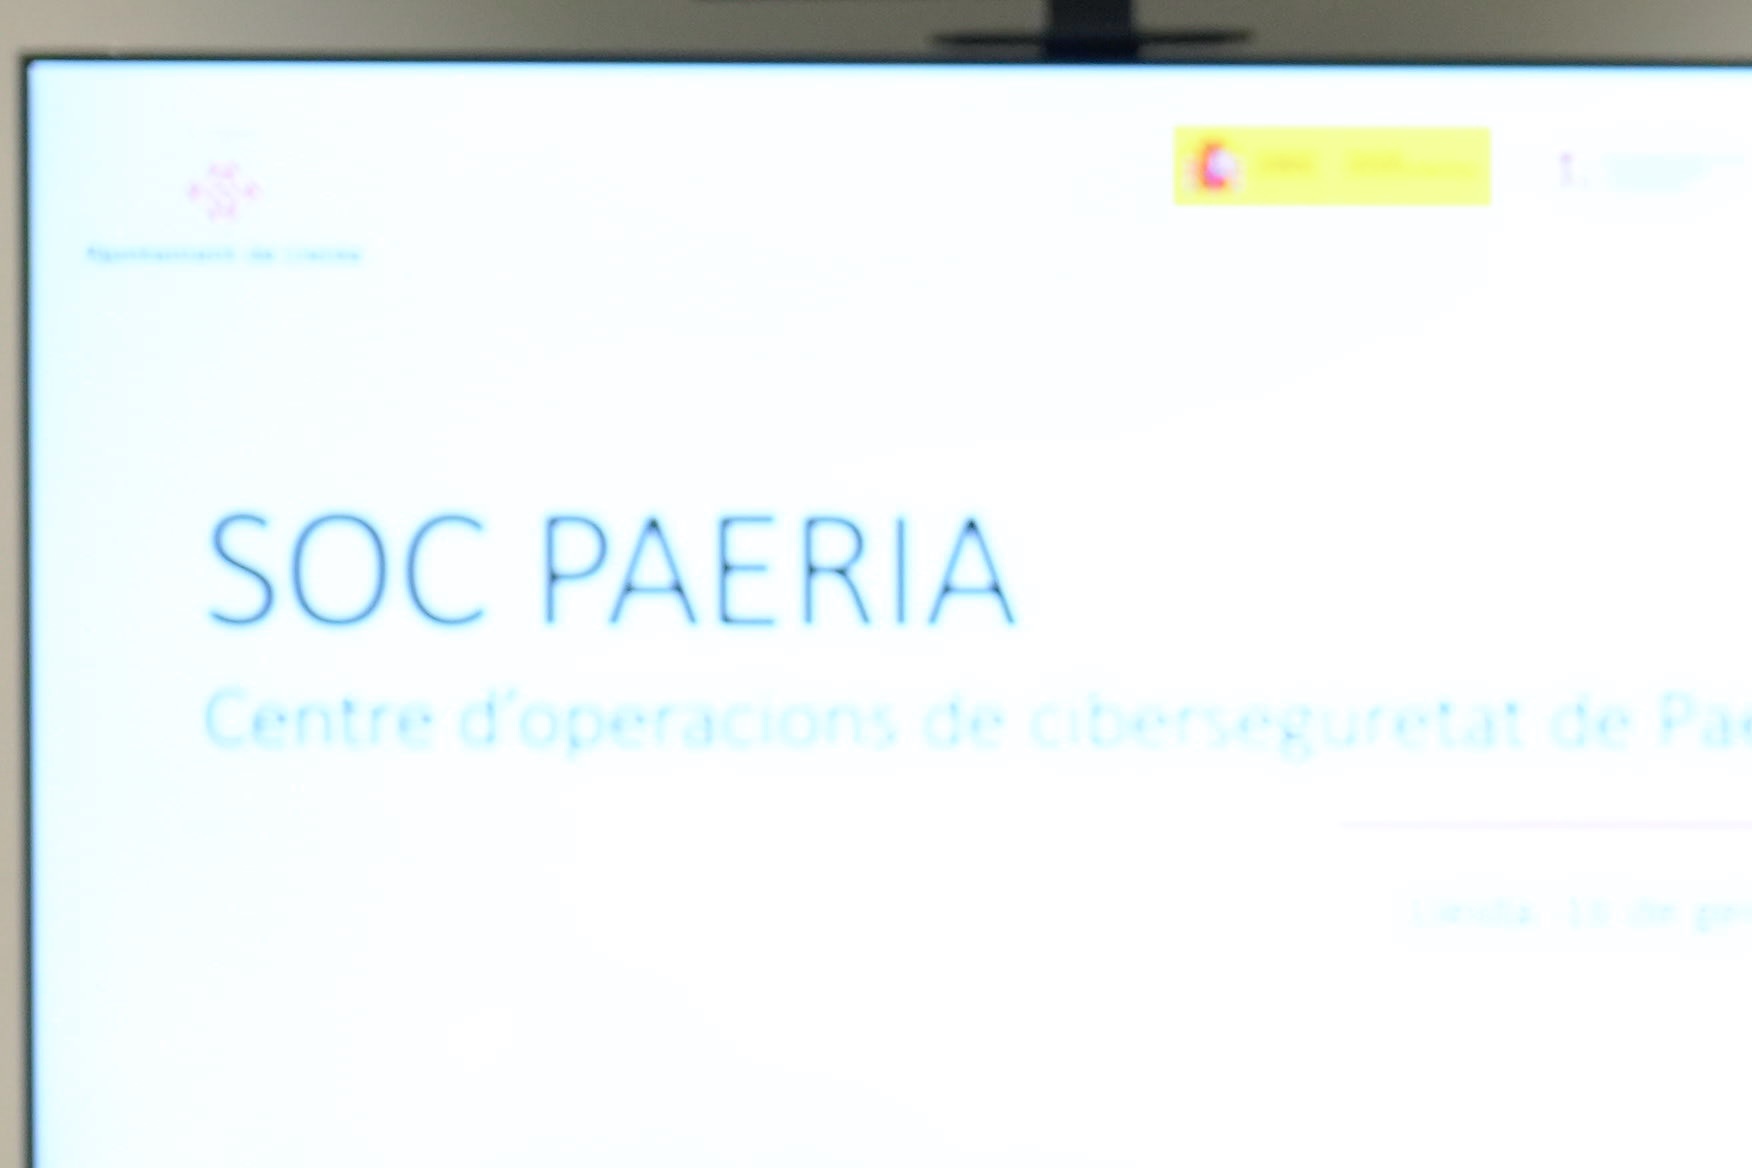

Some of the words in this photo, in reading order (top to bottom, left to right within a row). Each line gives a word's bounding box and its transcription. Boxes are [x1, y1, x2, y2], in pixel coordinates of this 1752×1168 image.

[207, 510, 486, 629] SOC
[542, 512, 1018, 629] PAERIA
[202, 684, 436, 752] Centre
[923, 693, 1006, 749] de
[1031, 692, 1521, 762] ciberseguretat
[1552, 692, 1632, 749] de
